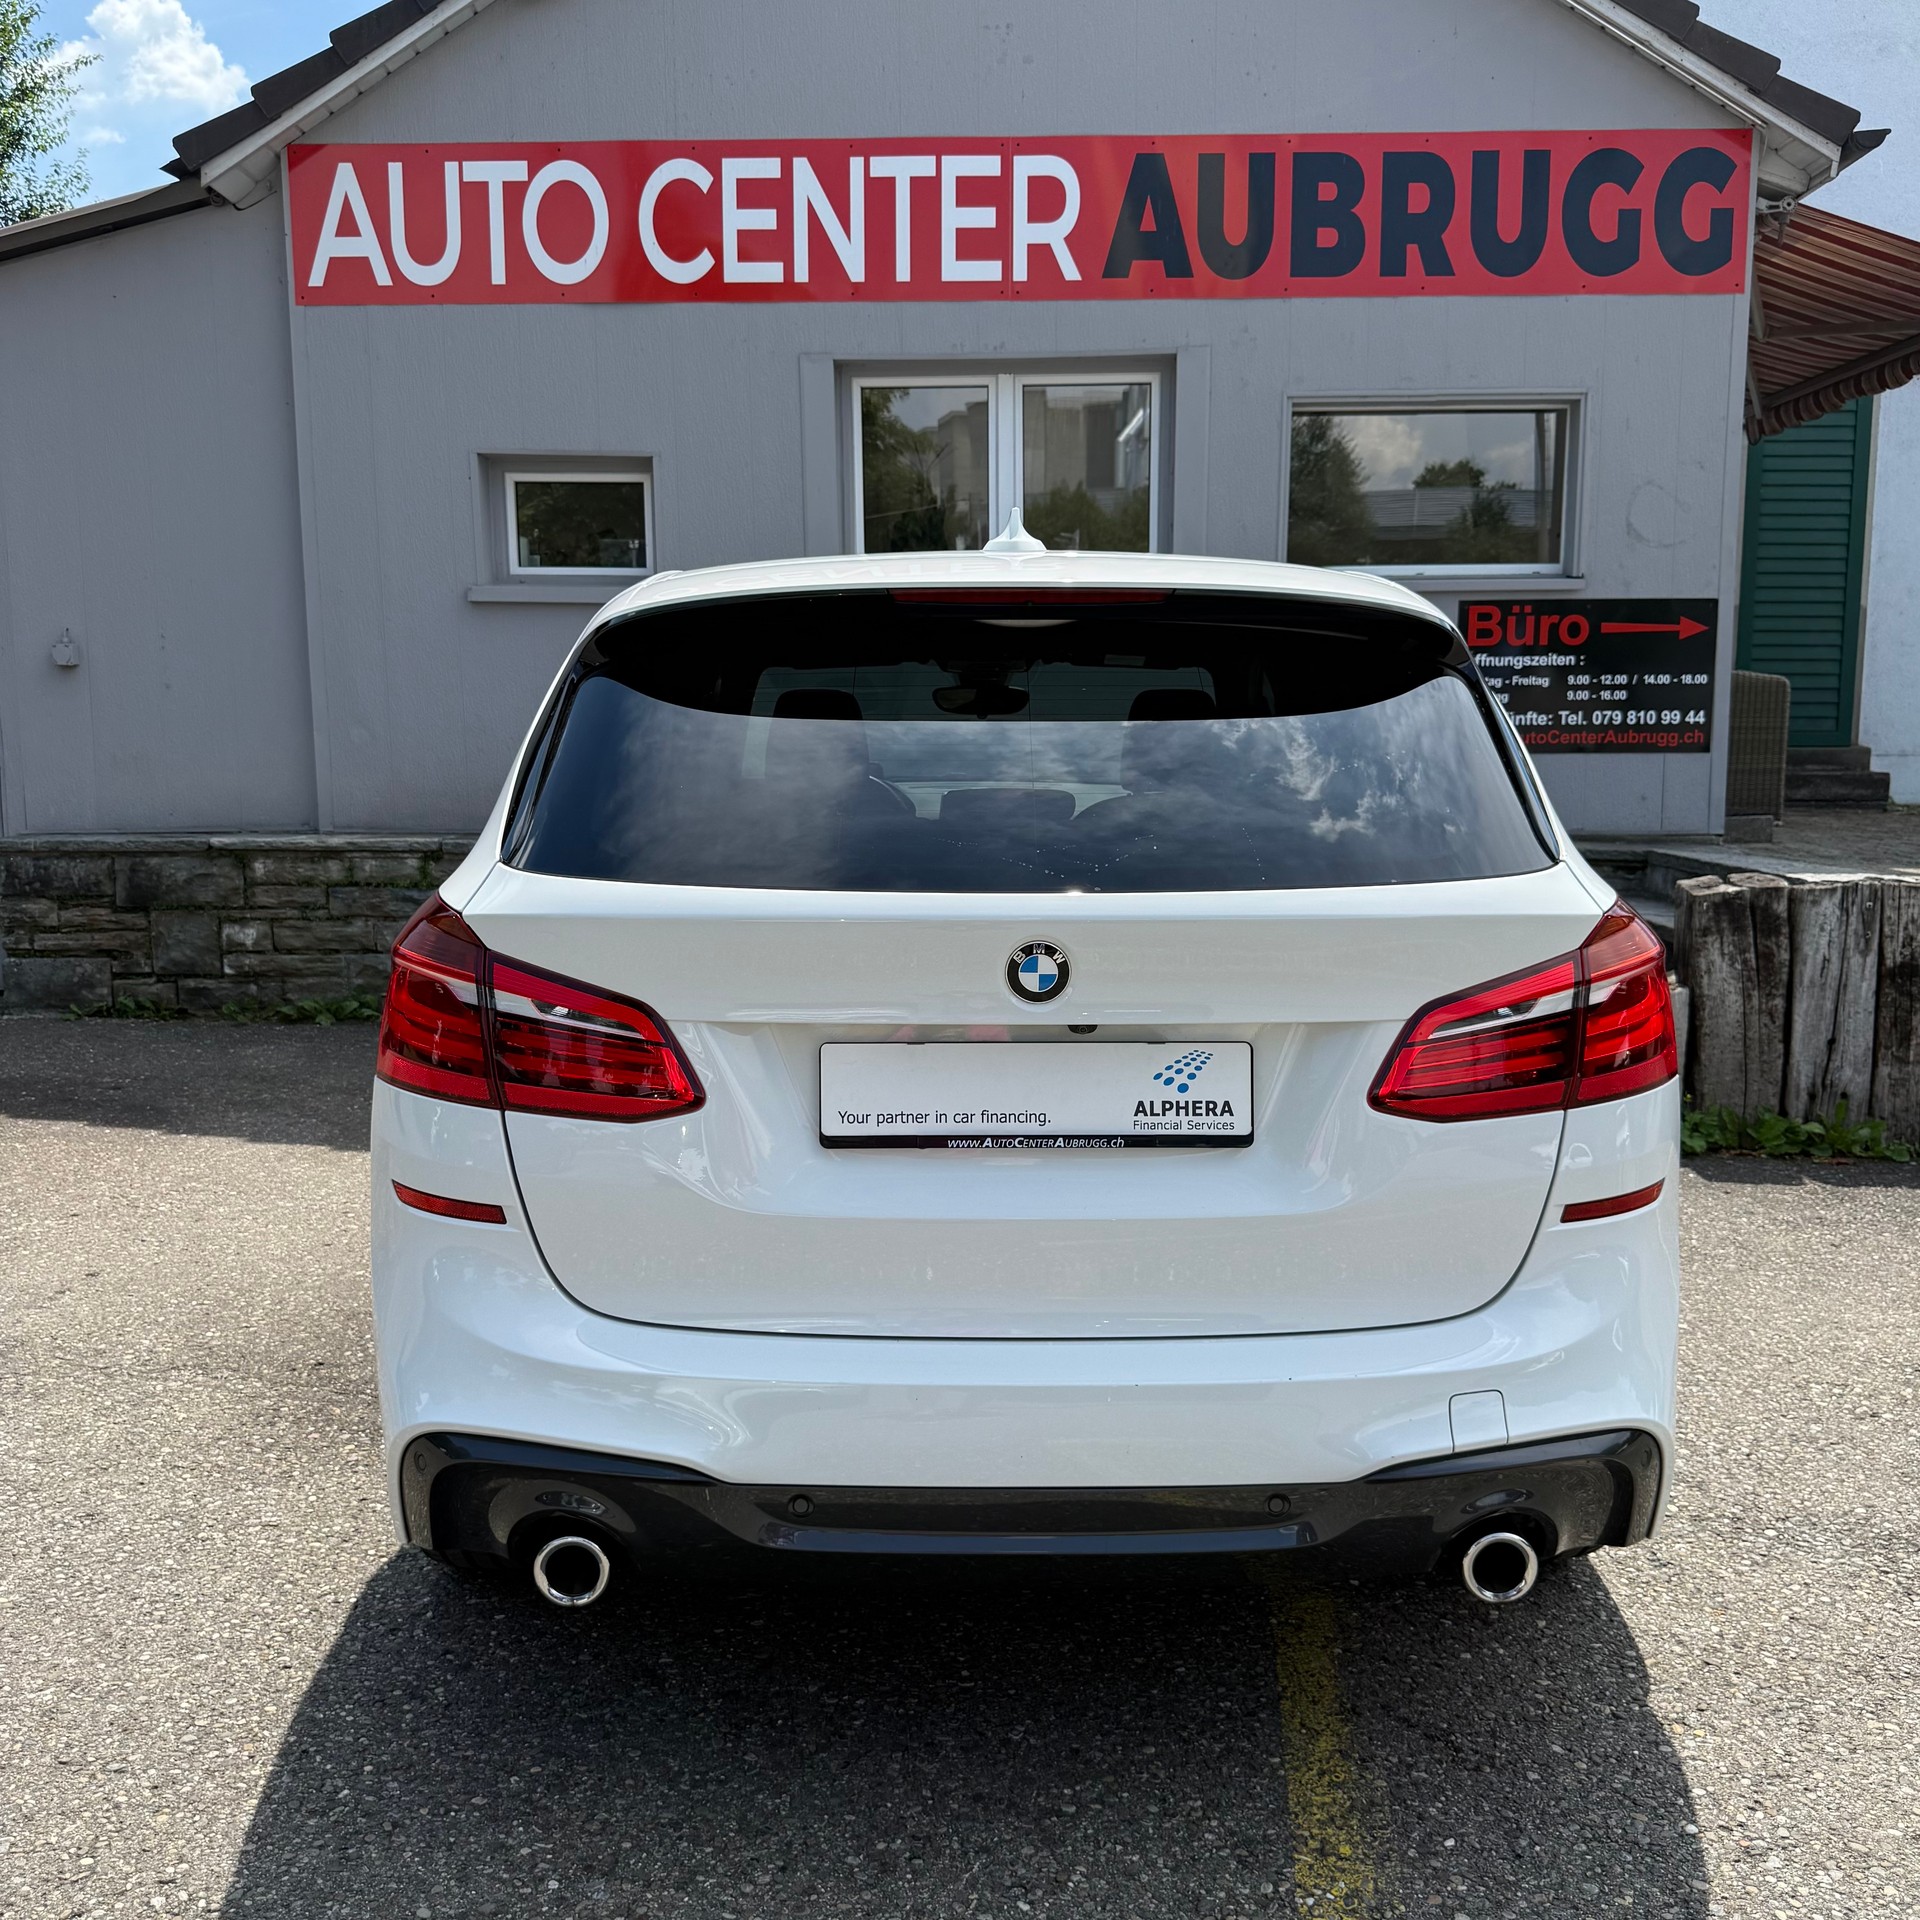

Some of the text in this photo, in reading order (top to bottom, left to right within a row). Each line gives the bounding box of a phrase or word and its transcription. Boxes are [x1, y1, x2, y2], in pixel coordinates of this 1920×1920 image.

[308, 147, 1738, 287] AUTO CENTER AUBRUGG
[1467, 604, 1590, 647] Büro
[1471, 652, 1577, 669] ffnungszeiten
[1511, 675, 1550, 688] Freitag
[1567, 674, 1590, 685] 9.00
[1601, 674, 1628, 685] 12.00
[1643, 674, 1670, 684] 14.00
[1681, 674, 1708, 684] 18.00
[1566, 690, 1589, 701] 9.00
[1600, 690, 1628, 701] 16.00
[1558, 711, 1587, 726] Tel.
[1592, 710, 1622, 725] 079
[1626, 710, 1656, 725] 810
[1661, 710, 1680, 725] 99
[1685, 709, 1706, 725] 44
[1521, 730, 1704, 747] utoCenterAubrugg.ch
[1013, 943, 1066, 964] BMW
[1133, 1100, 1235, 1117] ALPHERA
[838, 1109, 1052, 1127] Your partner in car financing.
[1133, 1119, 1235, 1131] Financial Services
